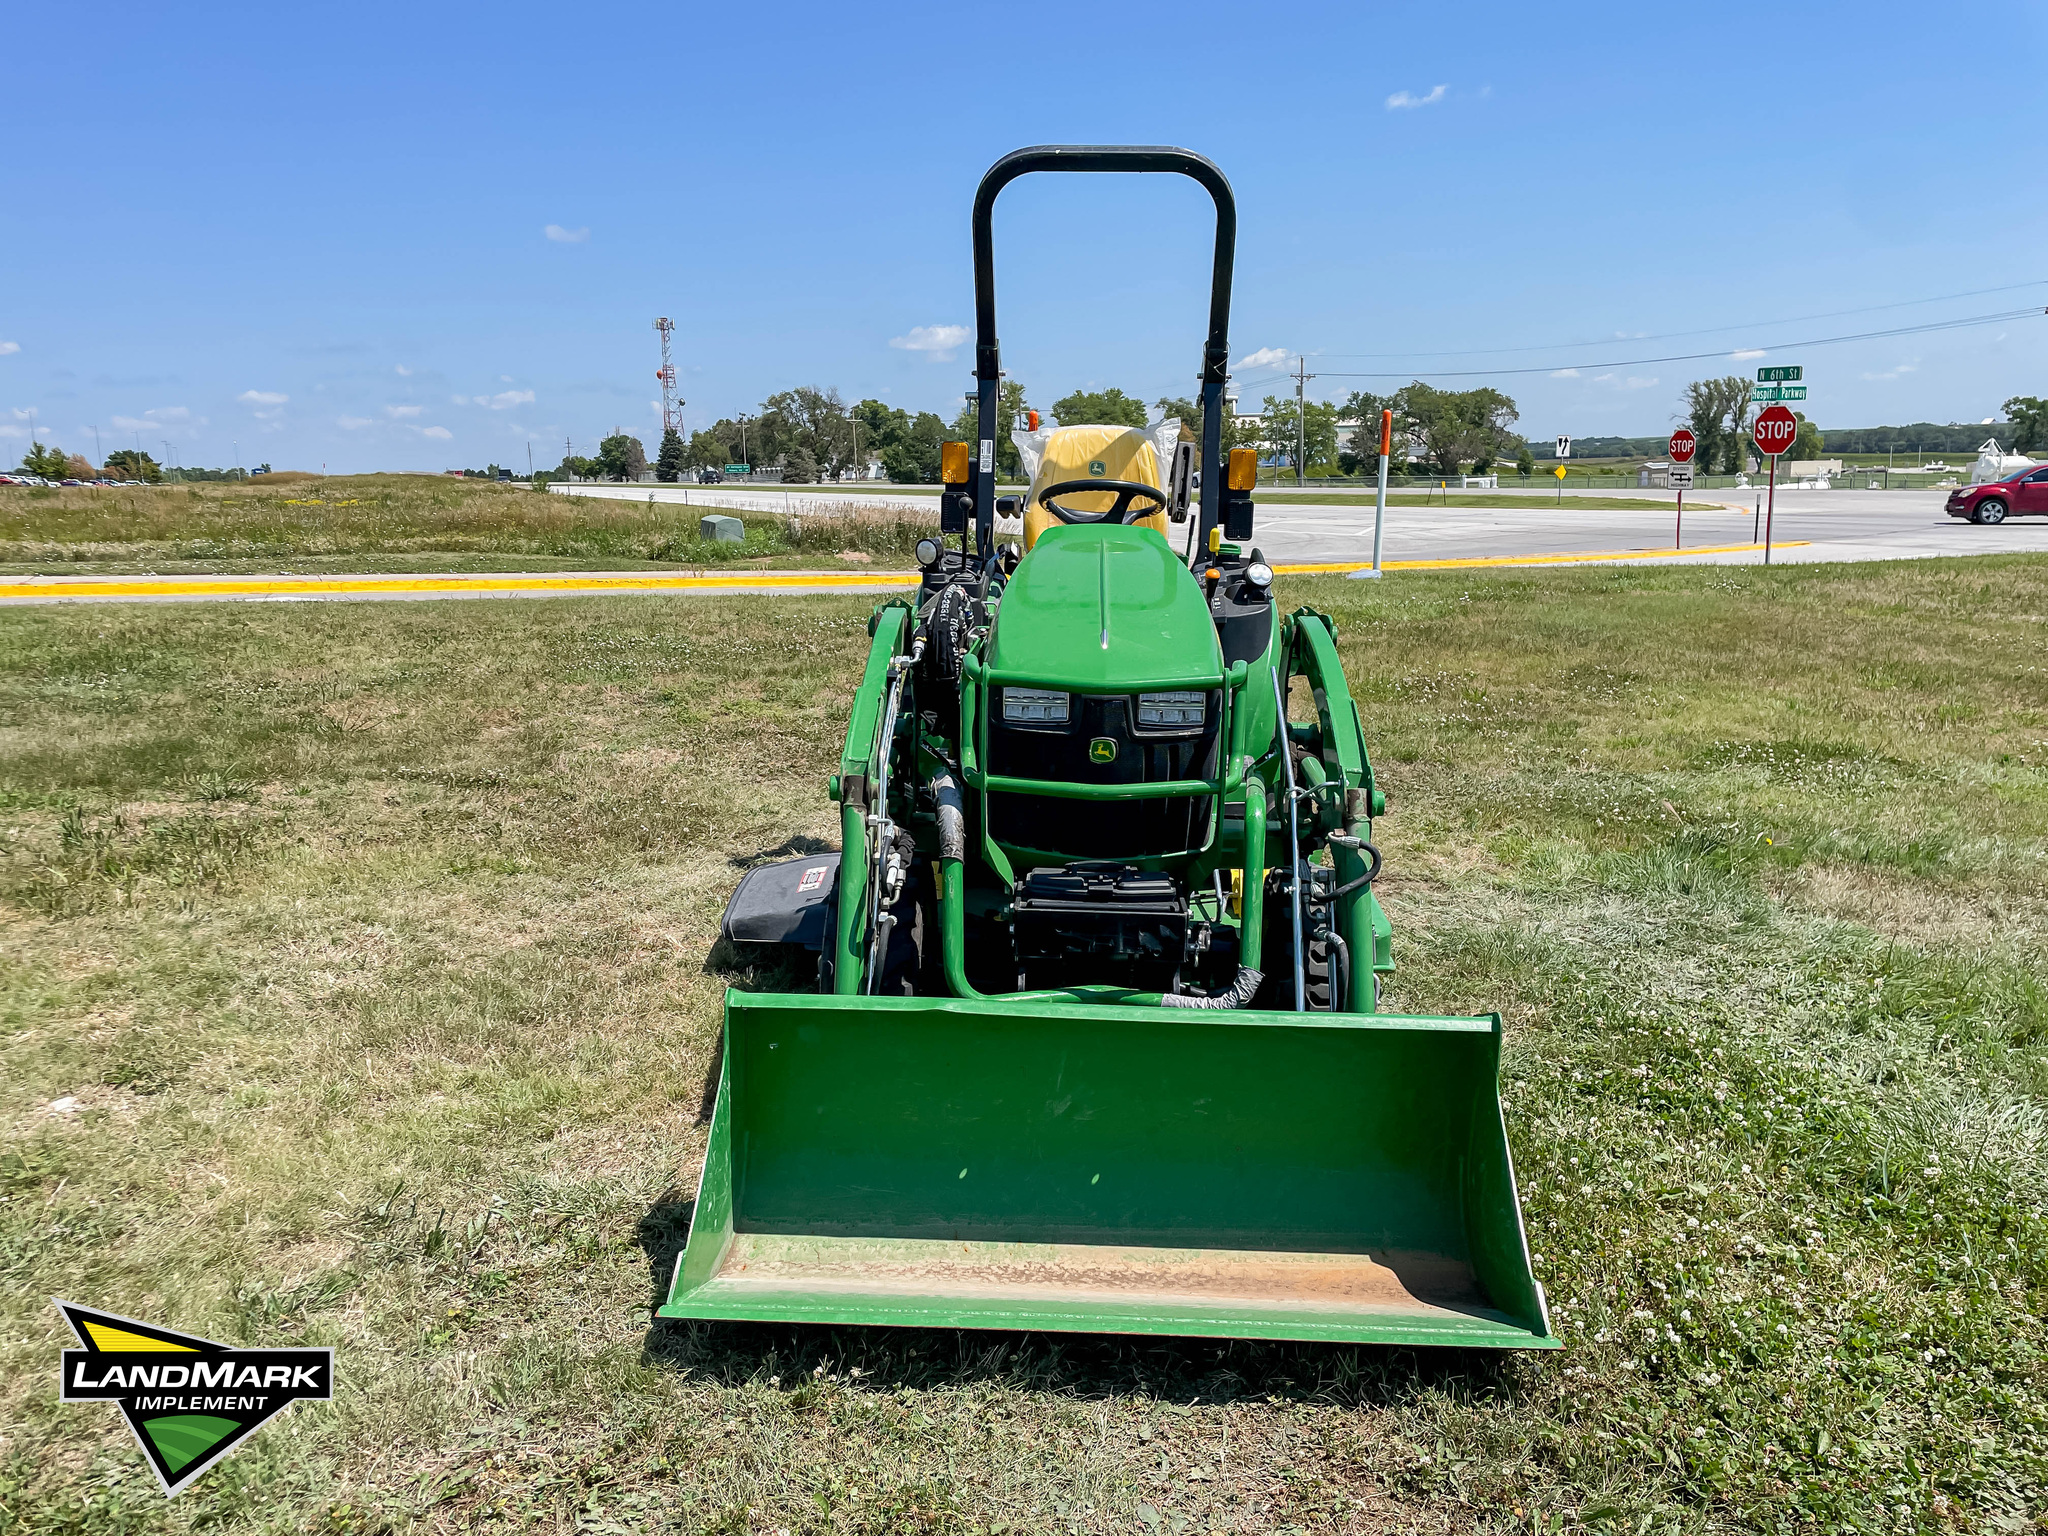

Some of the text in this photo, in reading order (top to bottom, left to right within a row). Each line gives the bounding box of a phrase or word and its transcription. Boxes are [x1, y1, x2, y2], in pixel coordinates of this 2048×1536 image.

[1759, 368, 1798, 380] N 6th St
[1752, 387, 1806, 401] Hospital Parkway
[1756, 420, 1794, 439] STOP
[1670, 440, 1694, 453] STOP
